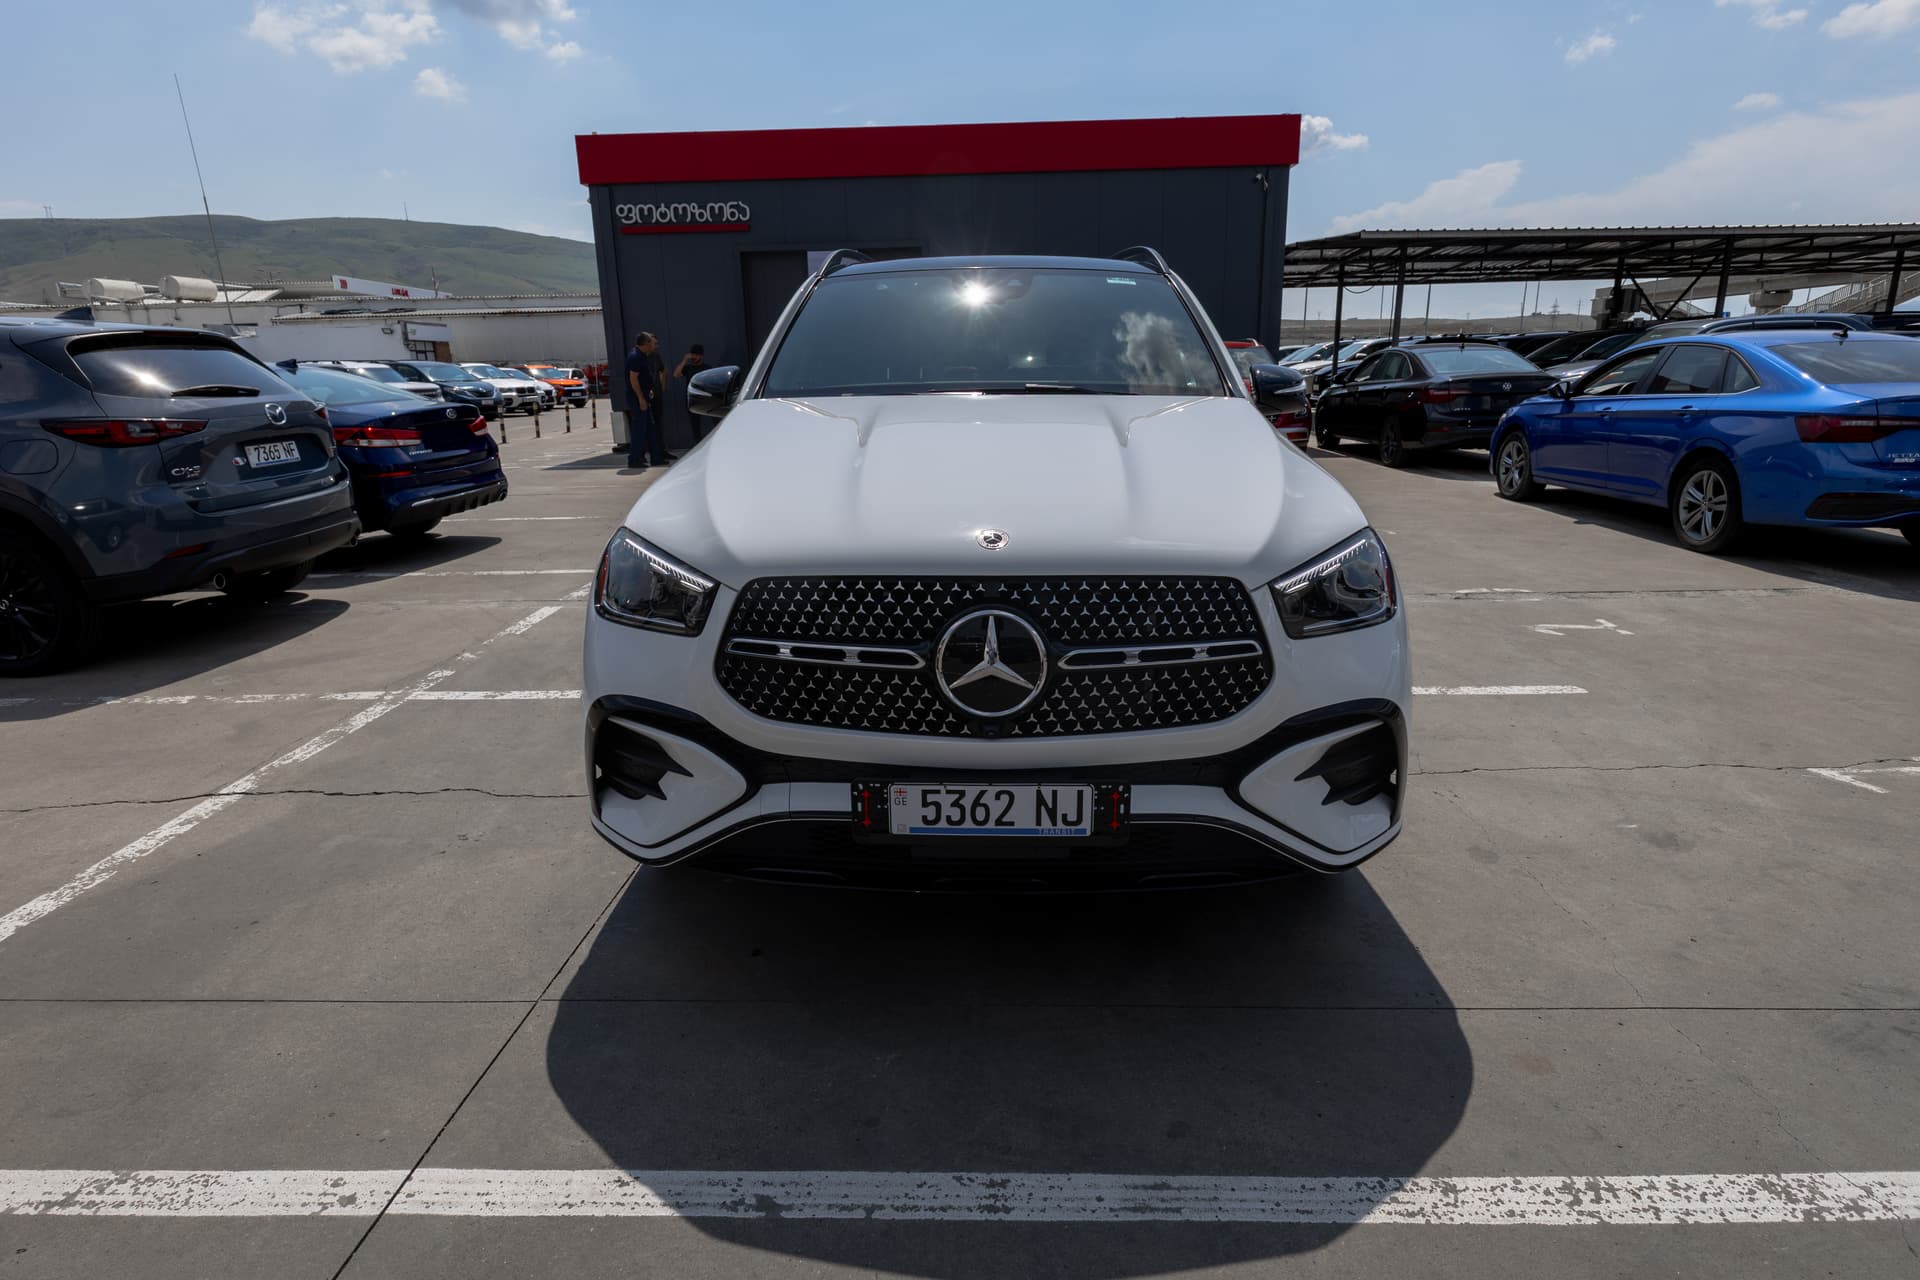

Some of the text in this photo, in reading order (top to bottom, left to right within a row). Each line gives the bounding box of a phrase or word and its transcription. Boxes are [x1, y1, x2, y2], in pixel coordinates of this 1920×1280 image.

[615, 201, 751, 224] ფოტოზონა
[254, 441, 296, 462] 7365 NF
[894, 797, 908, 806] GE
[920, 788, 1084, 827] 5362 NJ
